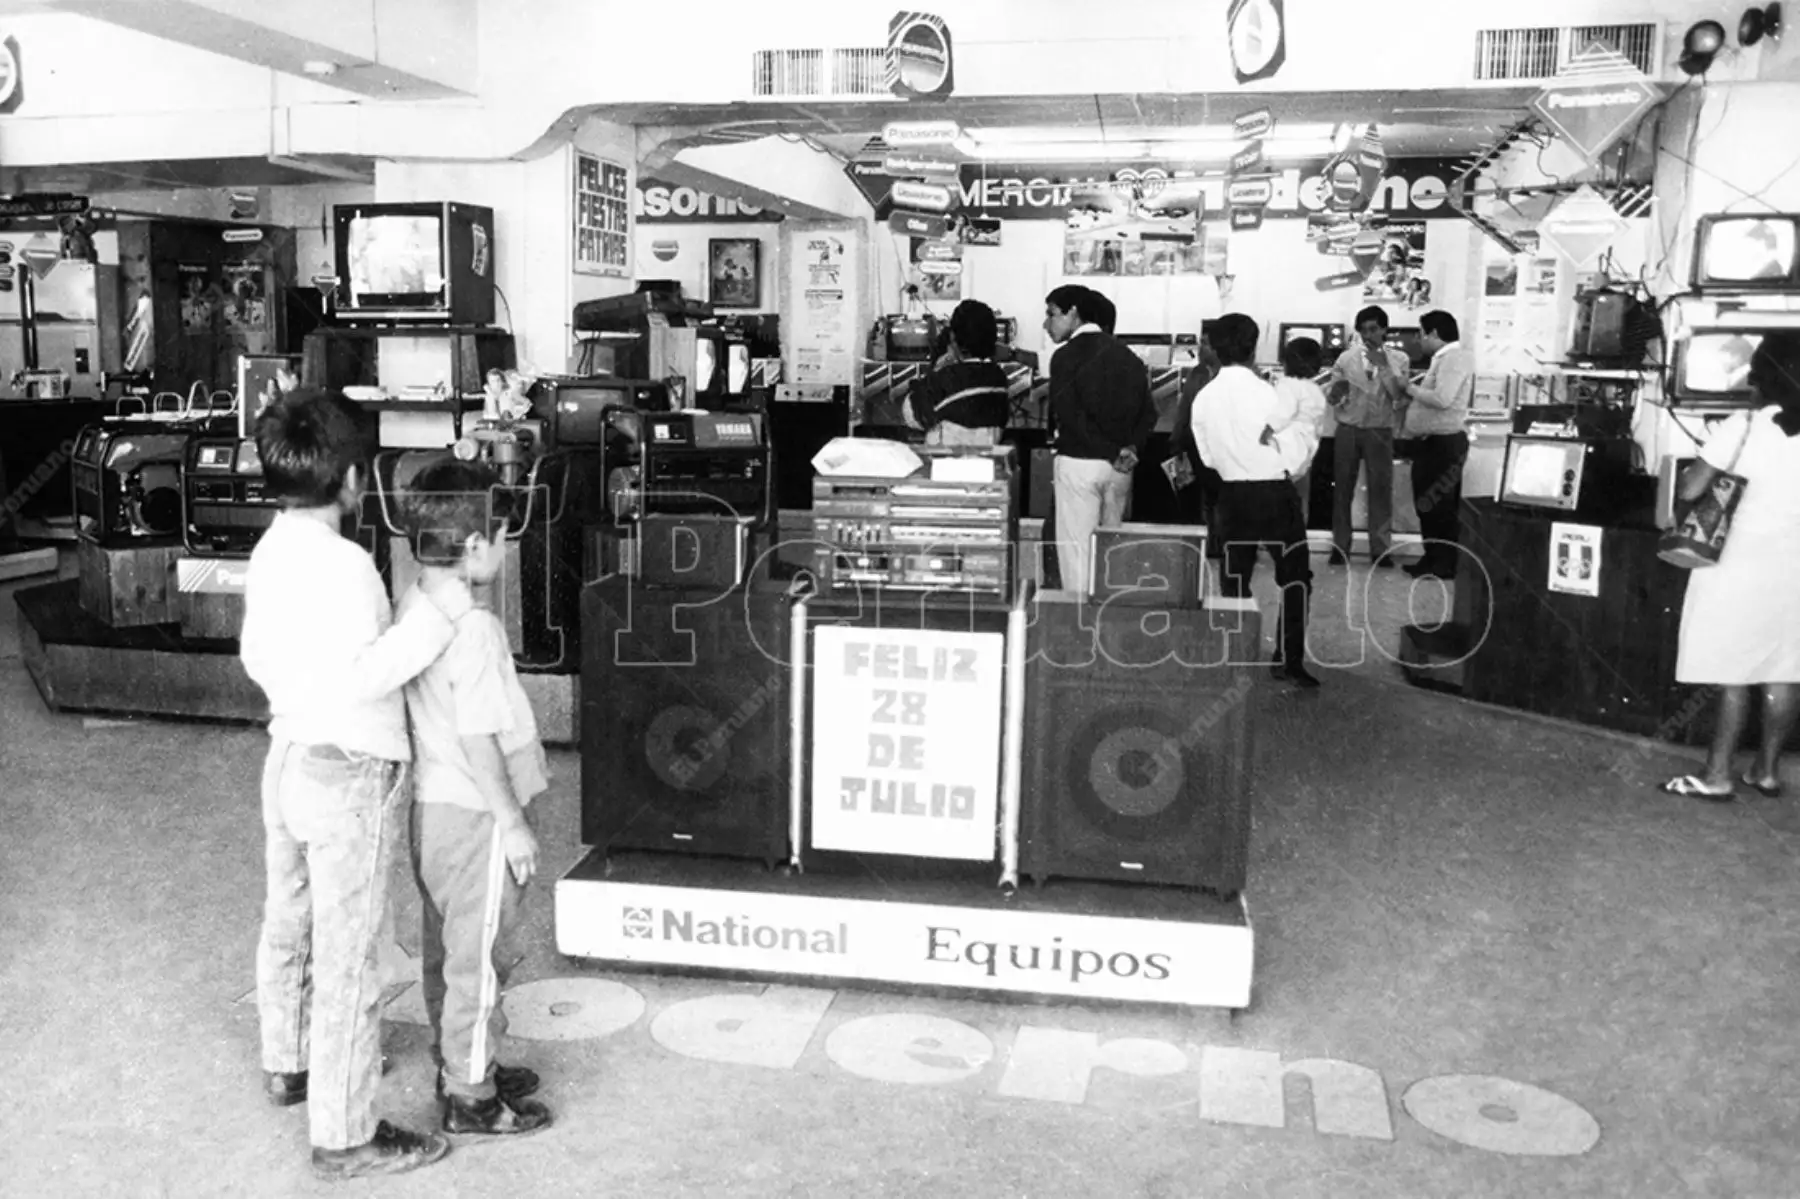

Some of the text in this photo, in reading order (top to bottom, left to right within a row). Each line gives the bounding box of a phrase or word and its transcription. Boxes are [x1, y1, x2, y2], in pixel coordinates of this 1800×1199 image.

[888, 127, 956, 140] Panasonic
[579, 155, 628, 201] FELICES
[579, 191, 628, 234] FIESTAS
[579, 226, 628, 266] PATRIAS
[842, 641, 979, 683] FELIZ
[872, 688, 928, 727] 28
[867, 731, 926, 771] DE
[838, 776, 977, 820] JULIO
[663, 909, 1172, 982] National Equipos
[235, 948, 1600, 1156] oderno
